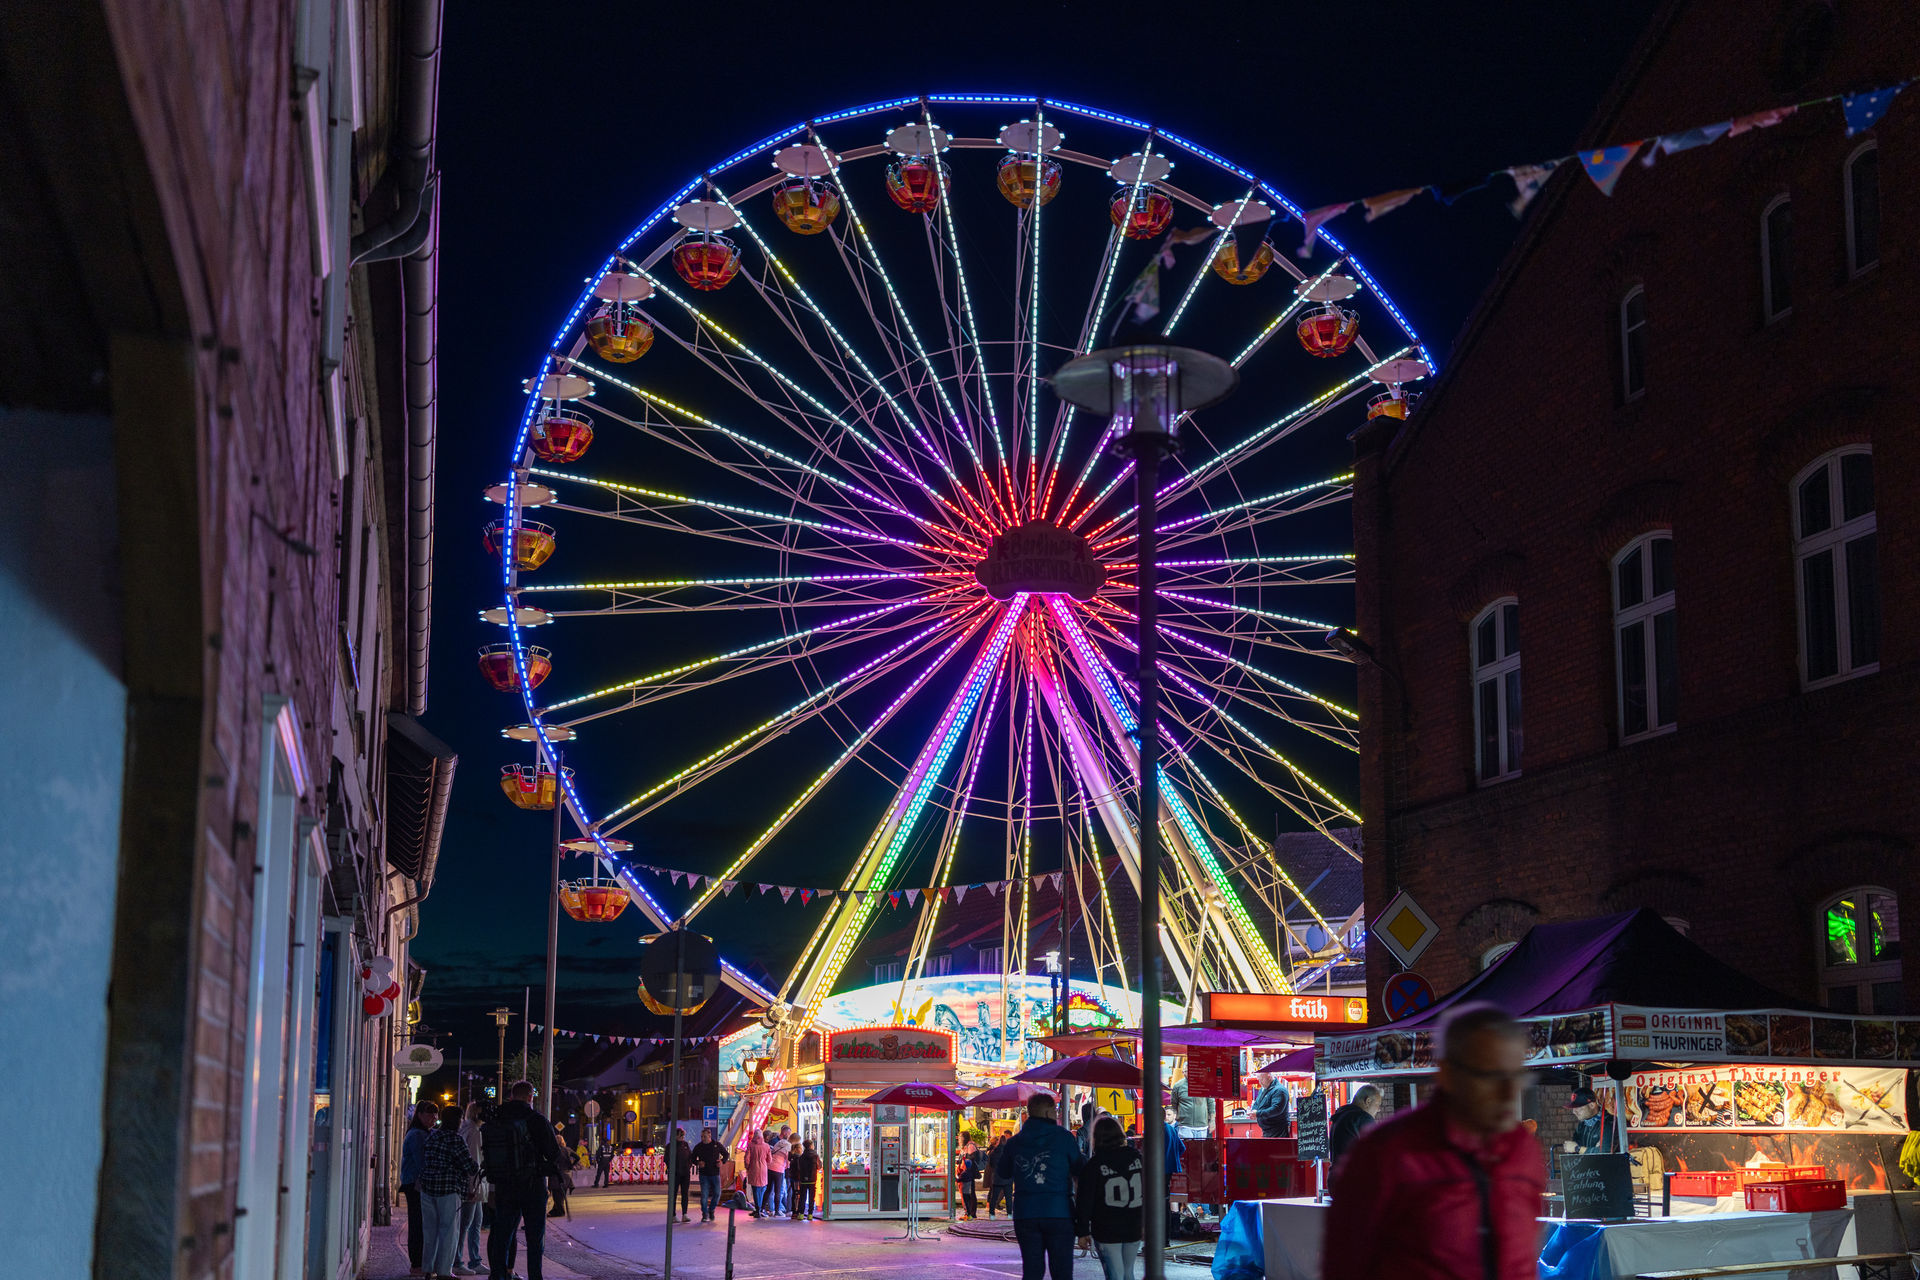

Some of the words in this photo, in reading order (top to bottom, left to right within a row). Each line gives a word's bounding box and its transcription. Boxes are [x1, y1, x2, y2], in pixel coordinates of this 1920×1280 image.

[990, 558, 1096, 585] RIESENRAD
[1652, 1014, 1722, 1030] ORIGINAL
[1330, 1039, 1372, 1054] ORIGINAL
[1621, 1036, 1648, 1046] HIER!
[833, 1044, 880, 1058] Little
[898, 1044, 948, 1058] Berlin
[1636, 1070, 1718, 1088] Original
[1729, 1067, 1841, 1085] Thüringer
[706, 1108, 715, 1118] P
[1104, 1172, 1143, 1208] 01
